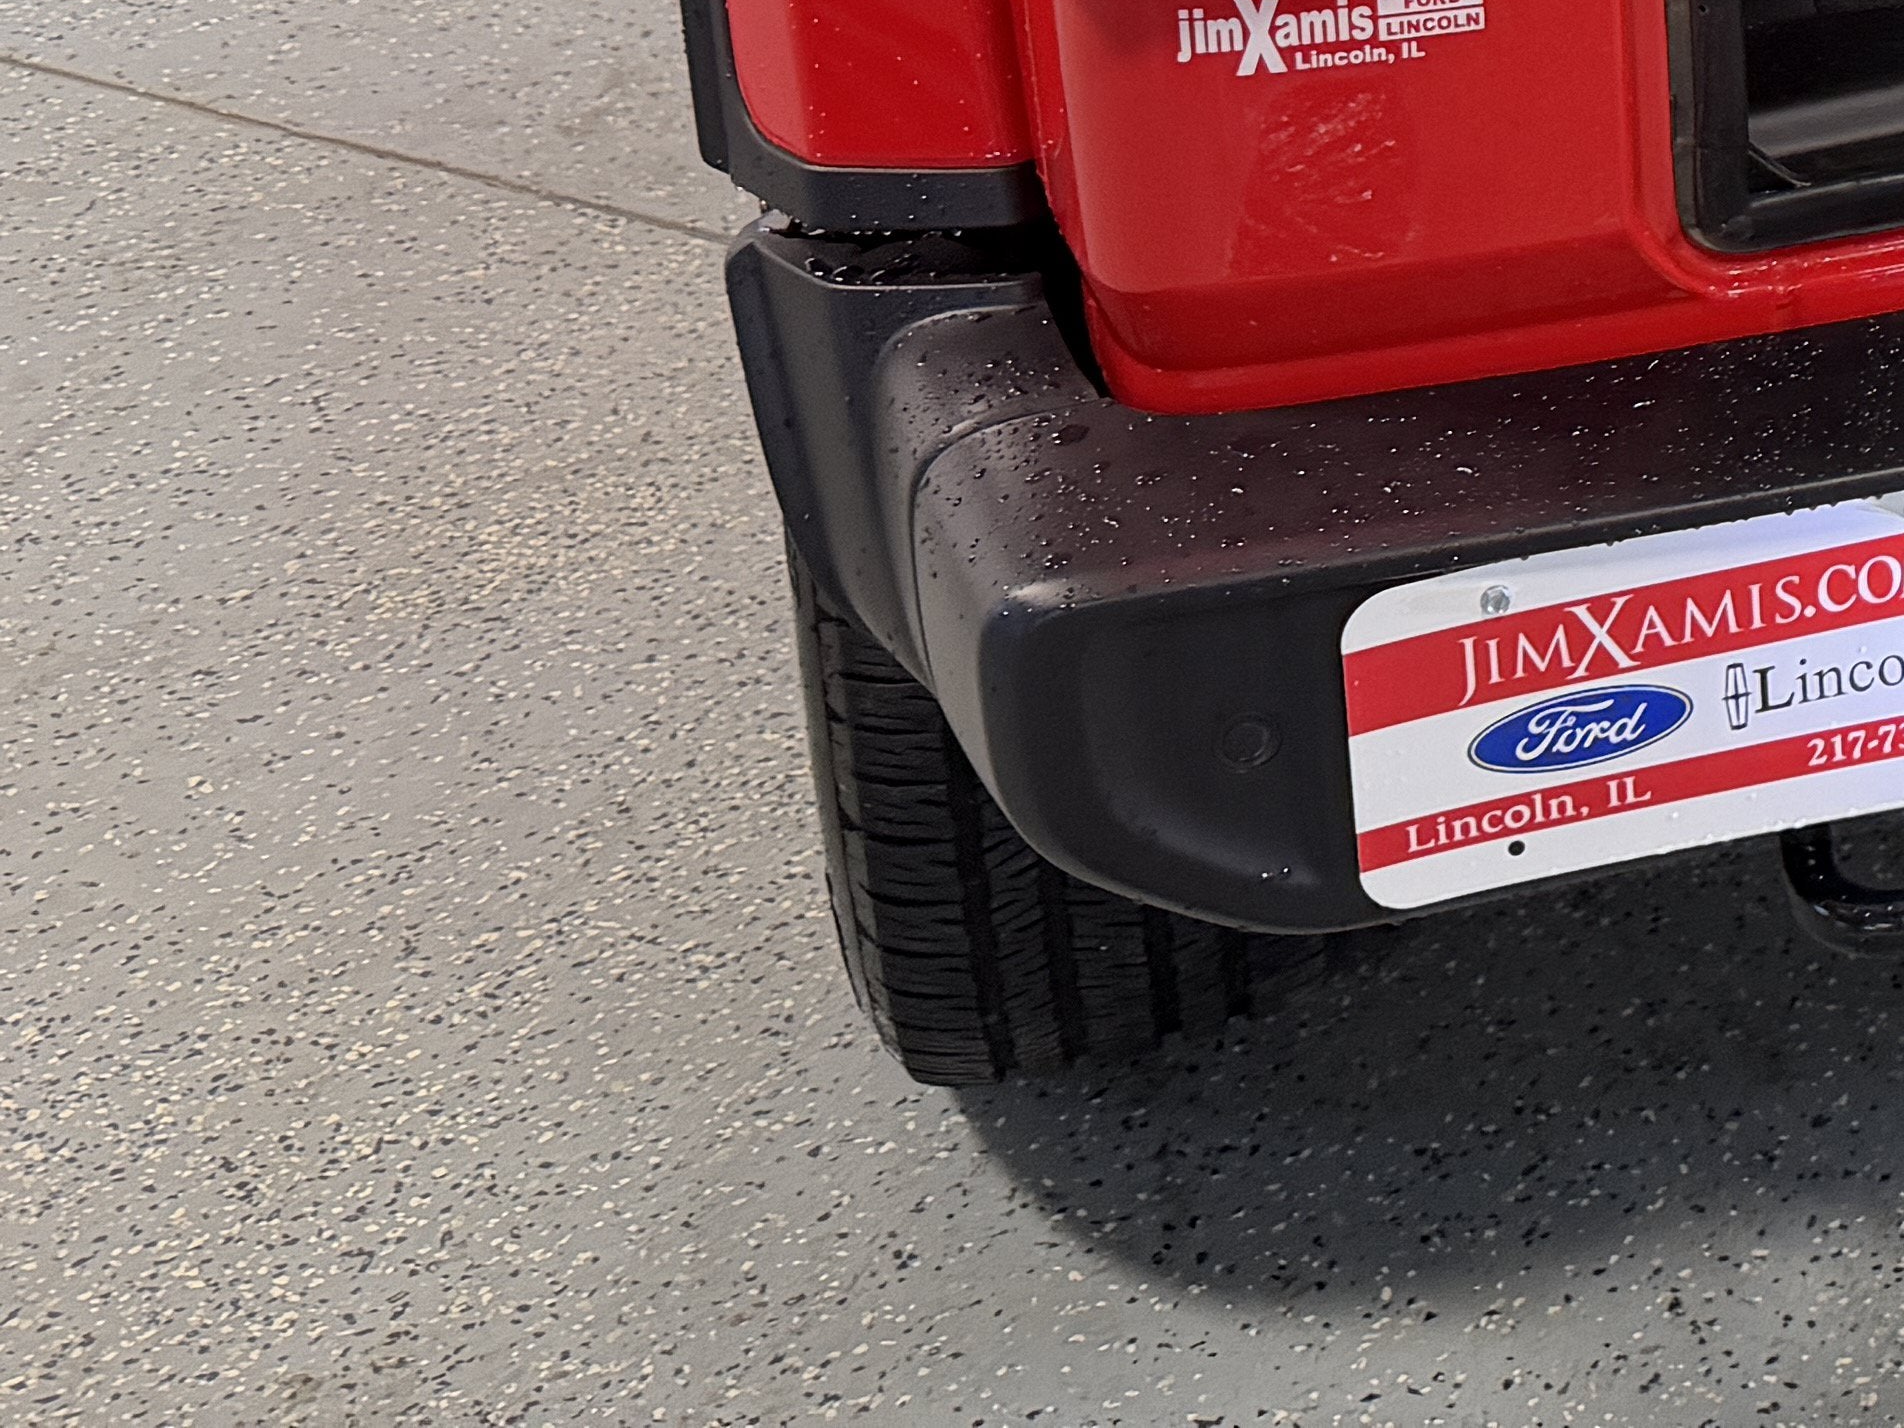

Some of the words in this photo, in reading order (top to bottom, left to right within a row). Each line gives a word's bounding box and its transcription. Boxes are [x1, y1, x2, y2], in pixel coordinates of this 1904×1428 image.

[1386, 13, 1481, 37] LINCOLN
[1294, 44, 1395, 70] Lincoln,
[1401, 40, 1426, 59] IL
[1515, 700, 1647, 761] Ford
[1406, 793, 1590, 852] Lincoln,
[1608, 777, 1651, 807] IL
